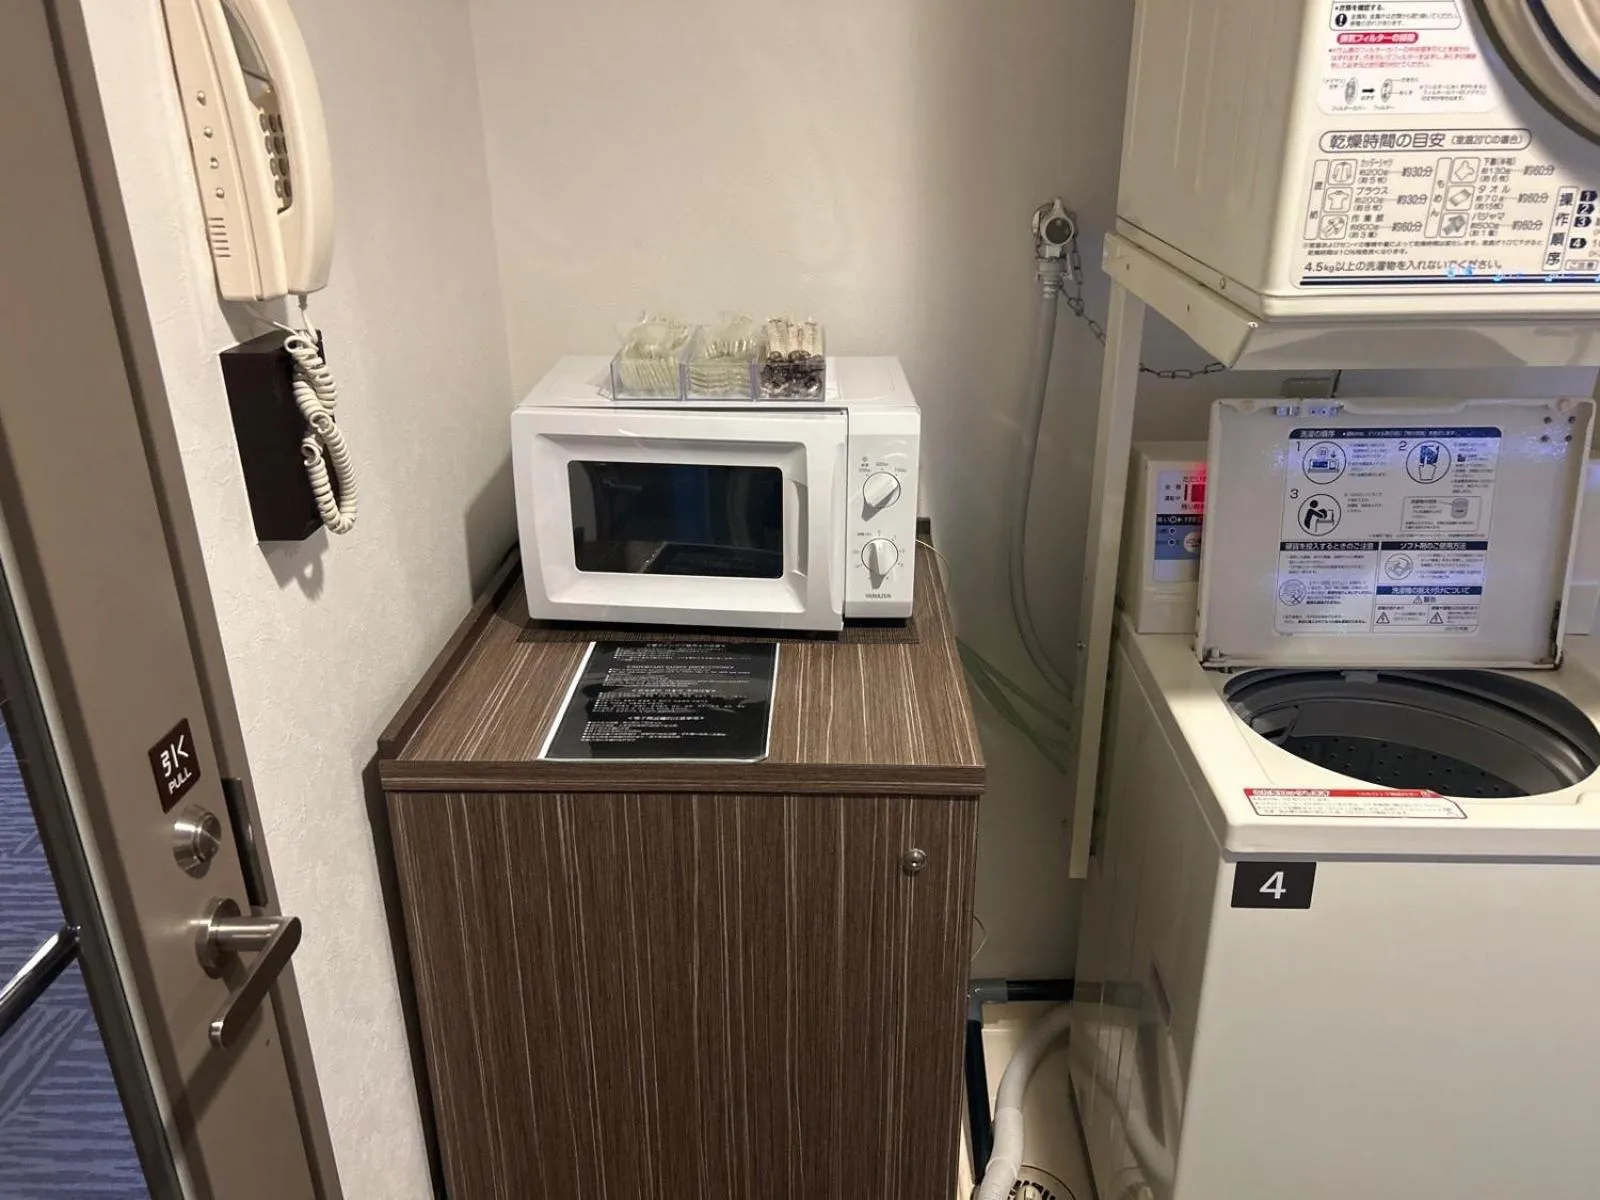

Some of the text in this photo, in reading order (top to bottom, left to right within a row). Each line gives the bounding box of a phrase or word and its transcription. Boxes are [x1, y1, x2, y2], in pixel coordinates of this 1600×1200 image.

[1329, 133, 1446, 149] 乾燥時間の目安
[1356, 187, 1389, 195] ブラウス
[1545, 192, 1573, 266] 操作順序
[1398, 440, 1407, 451] 2
[1289, 489, 1299, 499] 3
[160, 734, 189, 778] 引く
[168, 767, 192, 795] PULL
[1259, 871, 1287, 899] 4
